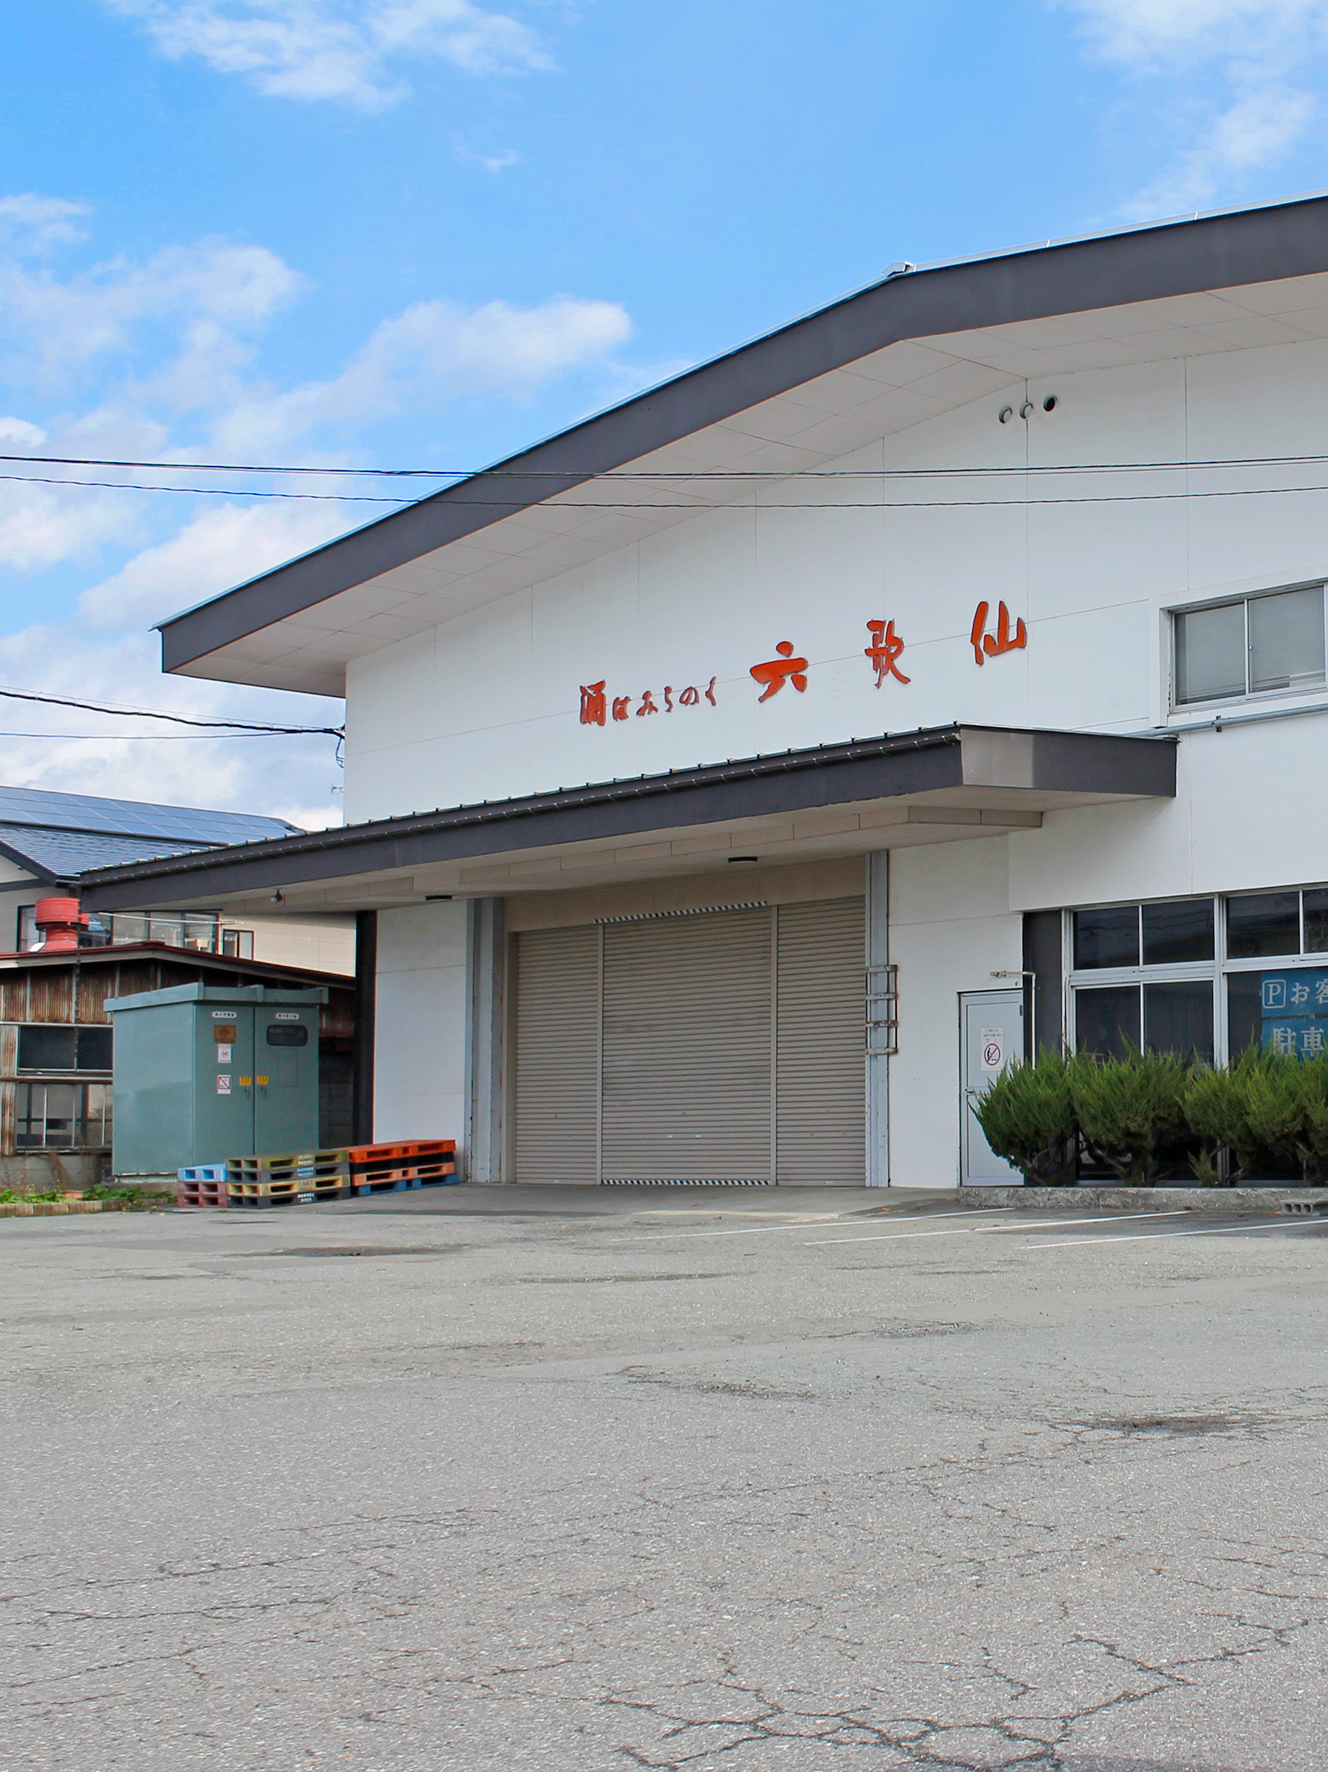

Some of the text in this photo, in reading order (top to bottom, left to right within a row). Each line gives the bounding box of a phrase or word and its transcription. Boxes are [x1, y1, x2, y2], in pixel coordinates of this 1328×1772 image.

[749, 600, 1027, 703] 六歌仙
[1267, 983, 1282, 1005] P
